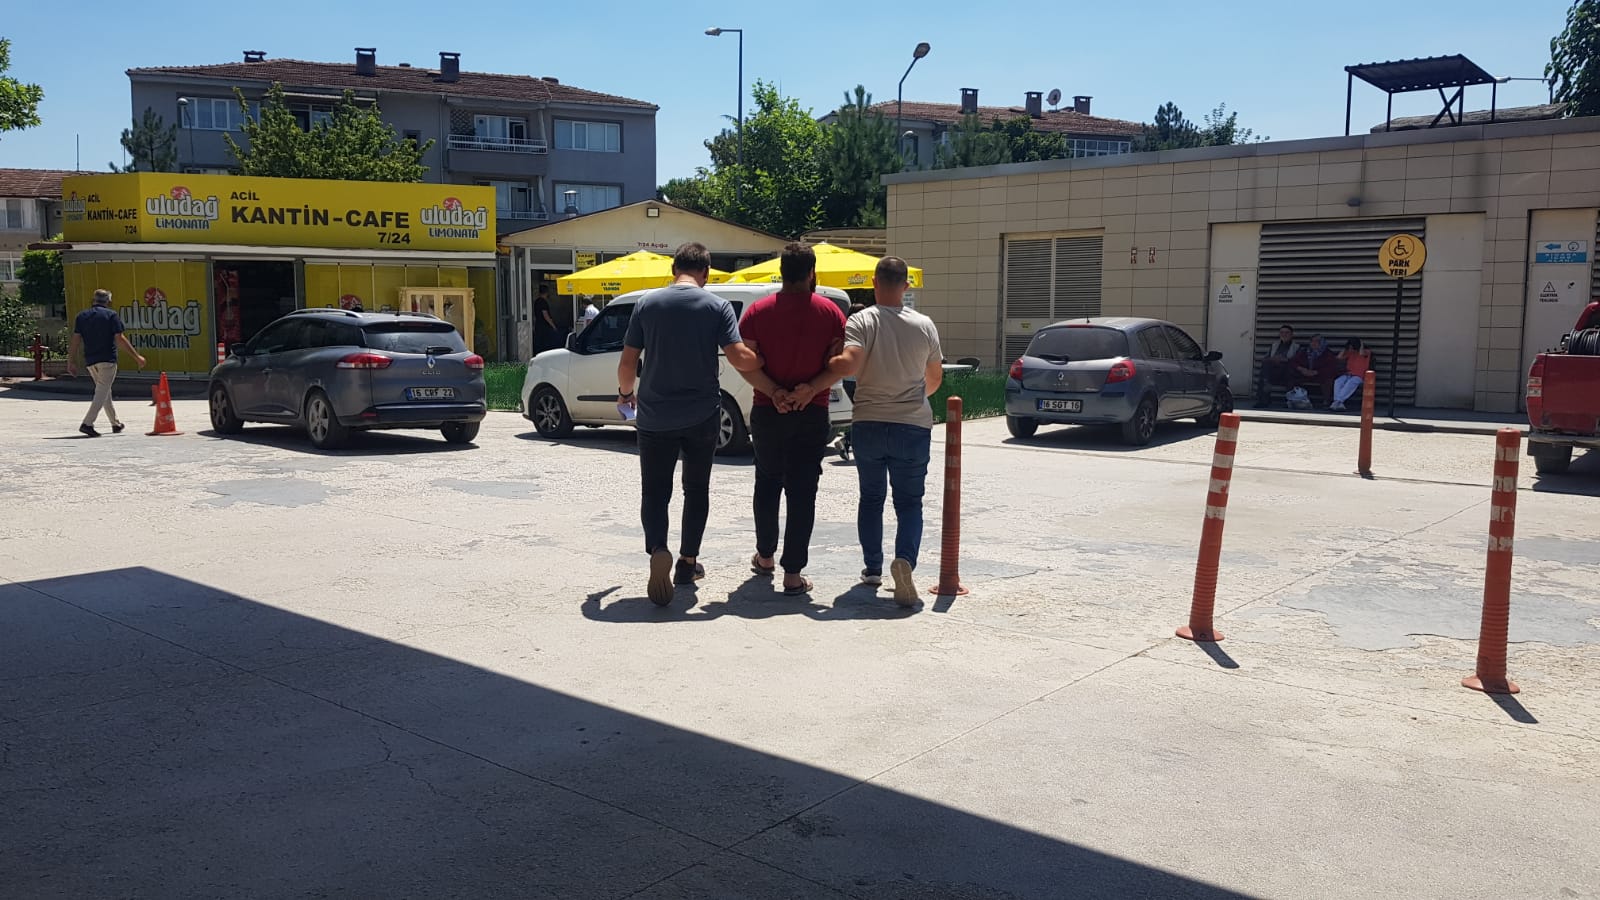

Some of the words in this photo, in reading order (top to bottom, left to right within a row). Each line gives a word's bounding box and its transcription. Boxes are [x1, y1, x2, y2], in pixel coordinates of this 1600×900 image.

[231, 191, 260, 201] ACİL
[146, 194, 219, 220] uludağ
[420, 203, 488, 230] uludağ
[377, 232, 411, 244] 7/24
[1388, 259, 1410, 267] PARK
